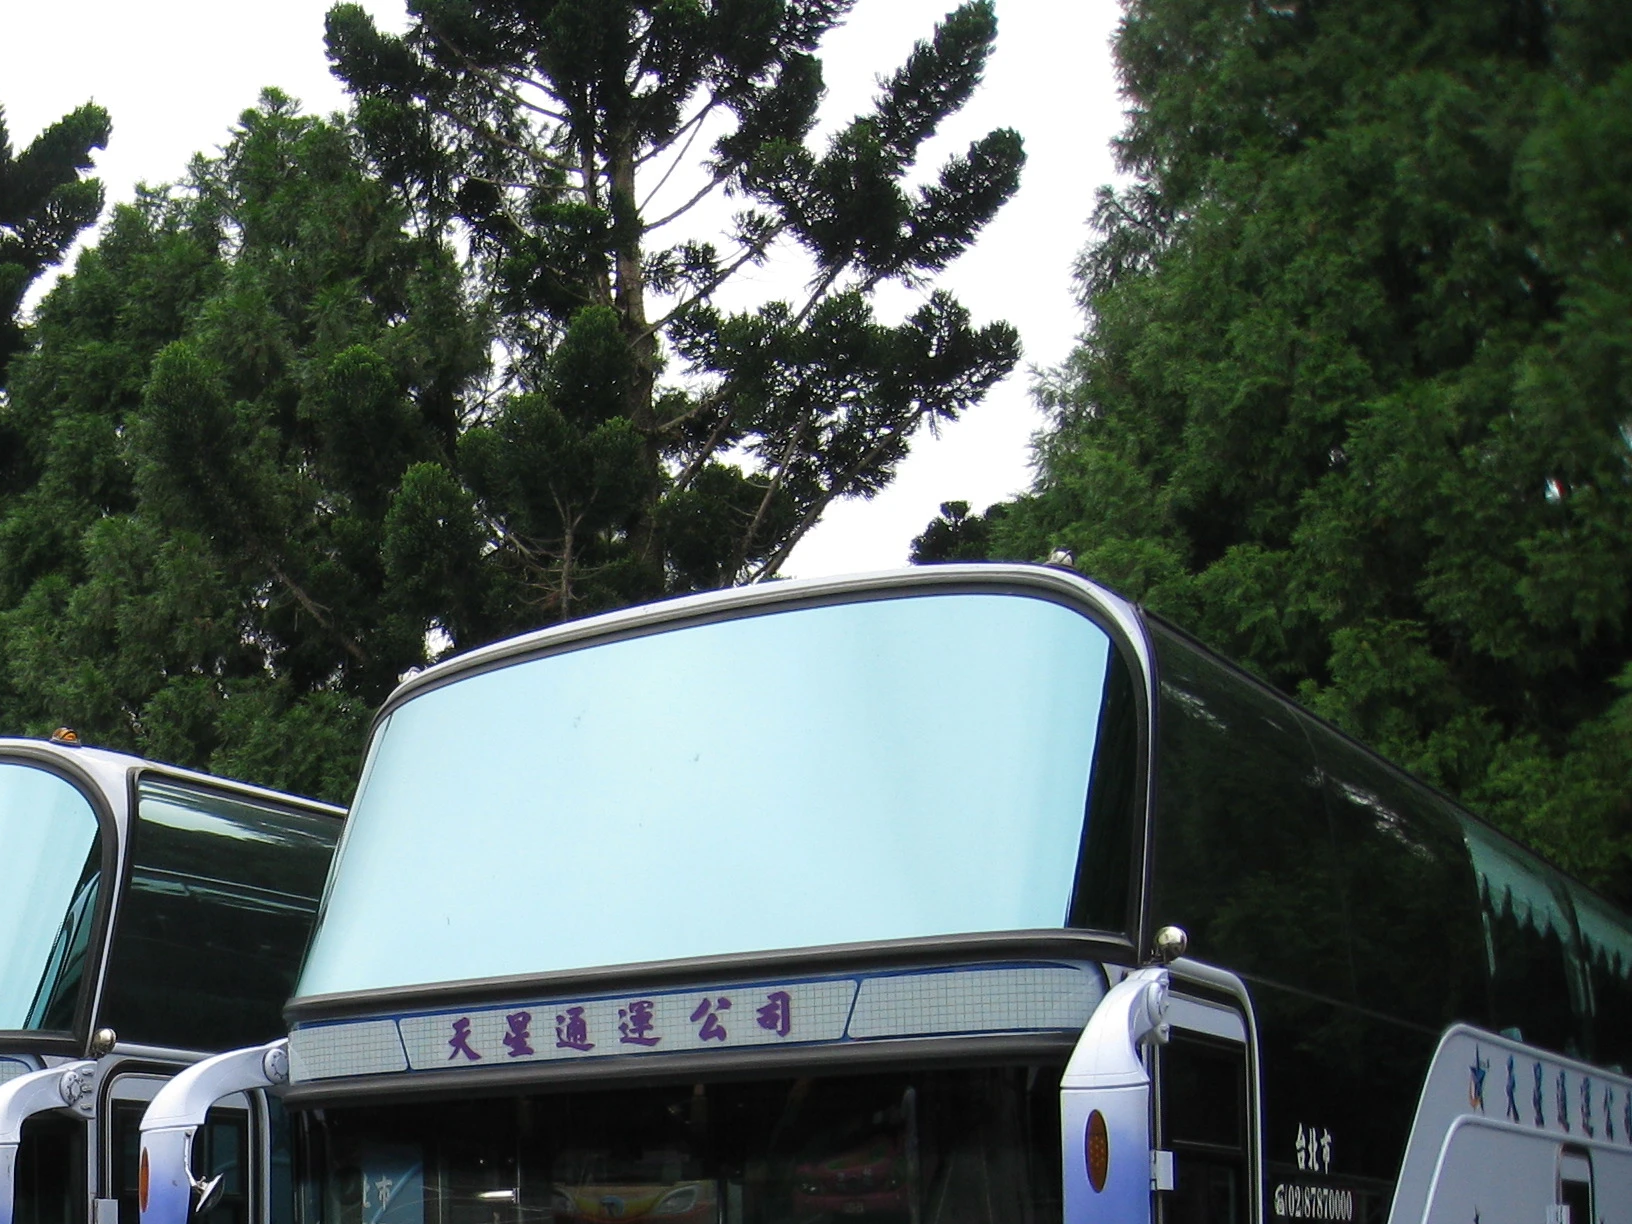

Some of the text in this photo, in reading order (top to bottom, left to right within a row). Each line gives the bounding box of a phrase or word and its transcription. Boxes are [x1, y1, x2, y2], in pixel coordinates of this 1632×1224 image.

[448, 991, 792, 1061] 天星通運公司
[1295, 1122, 1332, 1175] 台北市
